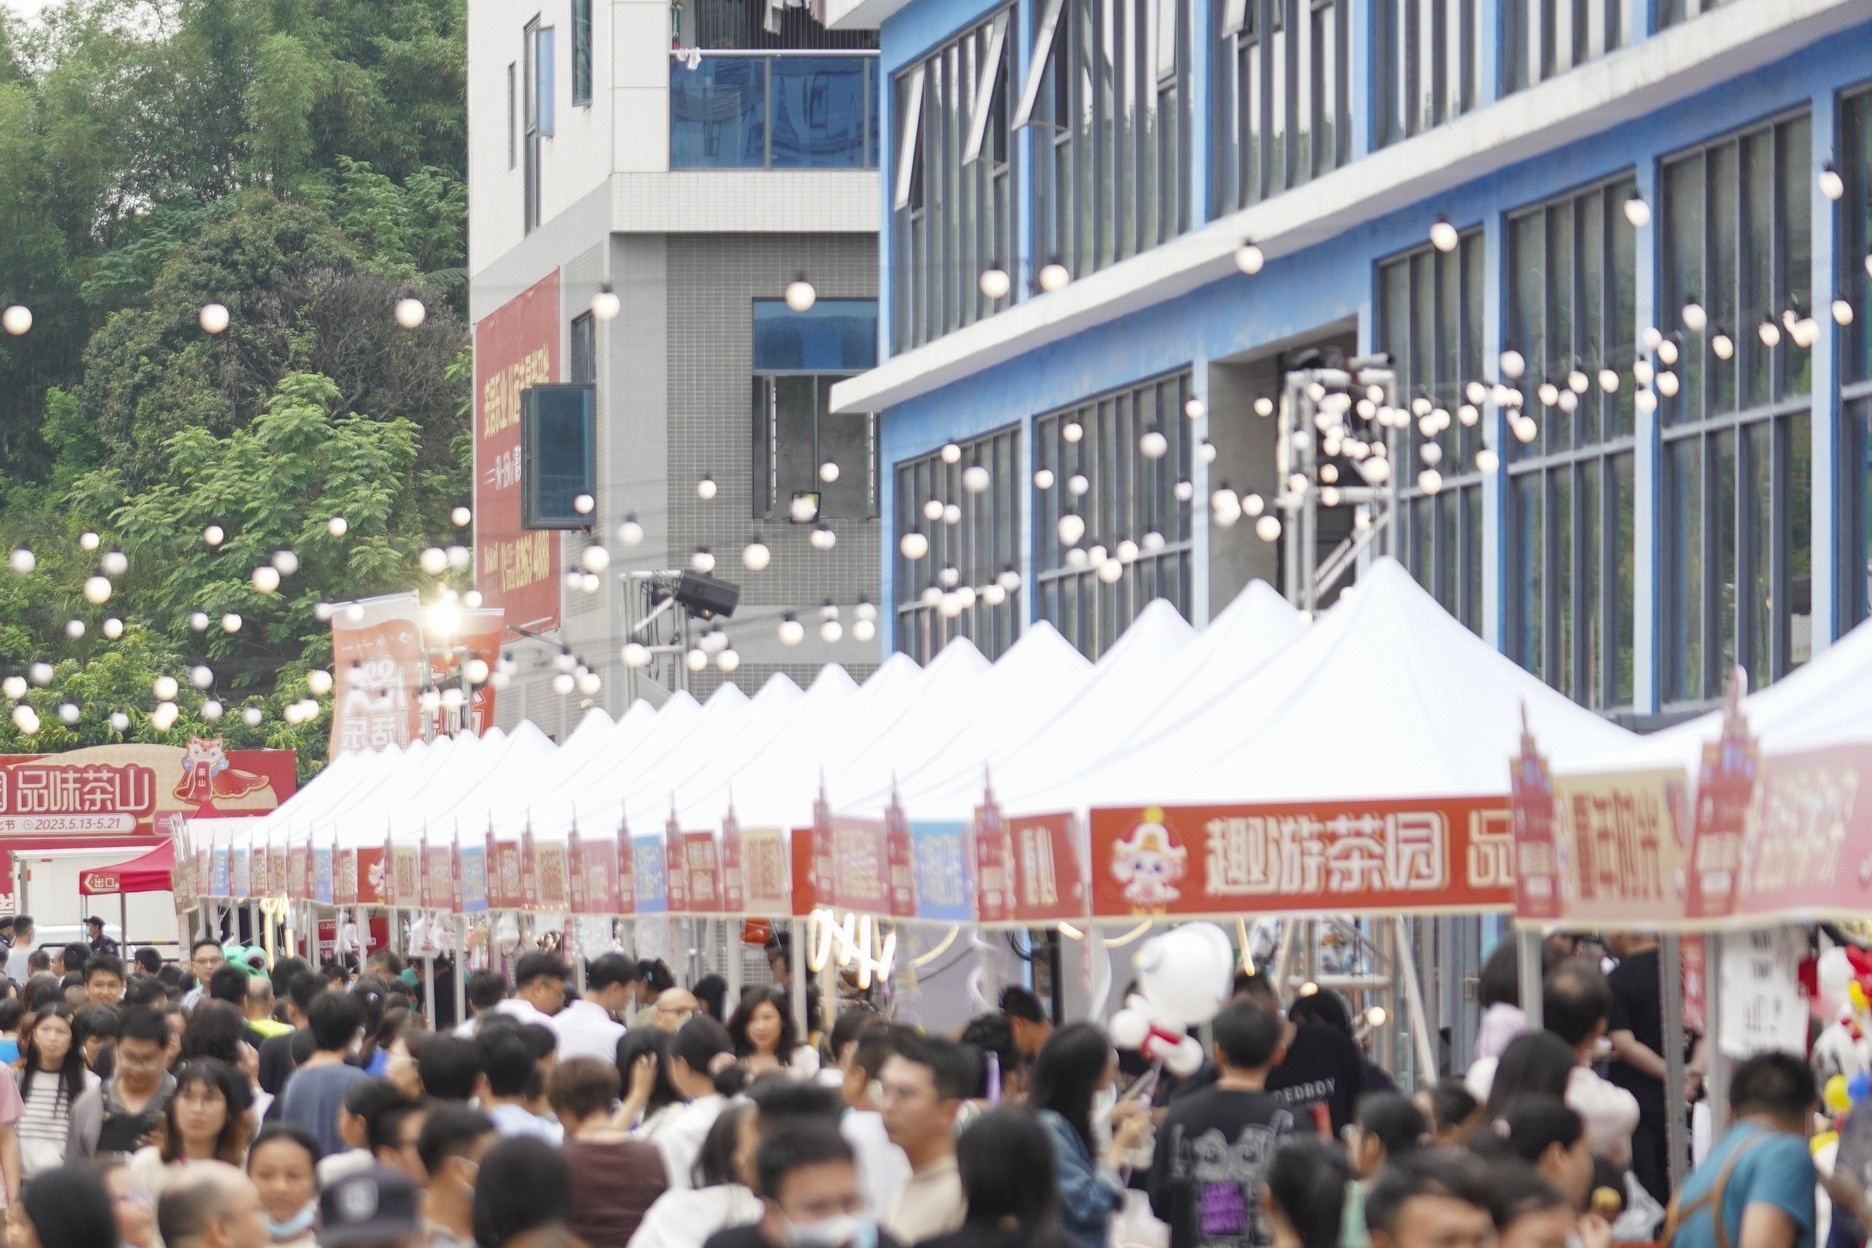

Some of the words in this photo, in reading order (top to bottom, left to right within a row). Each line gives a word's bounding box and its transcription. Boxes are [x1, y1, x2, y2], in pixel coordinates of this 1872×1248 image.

[16, 767, 149, 812] 品味茶山
[34, 817, 121, 831] 2023.5.13-5.21
[1204, 809, 1446, 896] 趣游茶园
[94, 877, 115, 888] 出口
